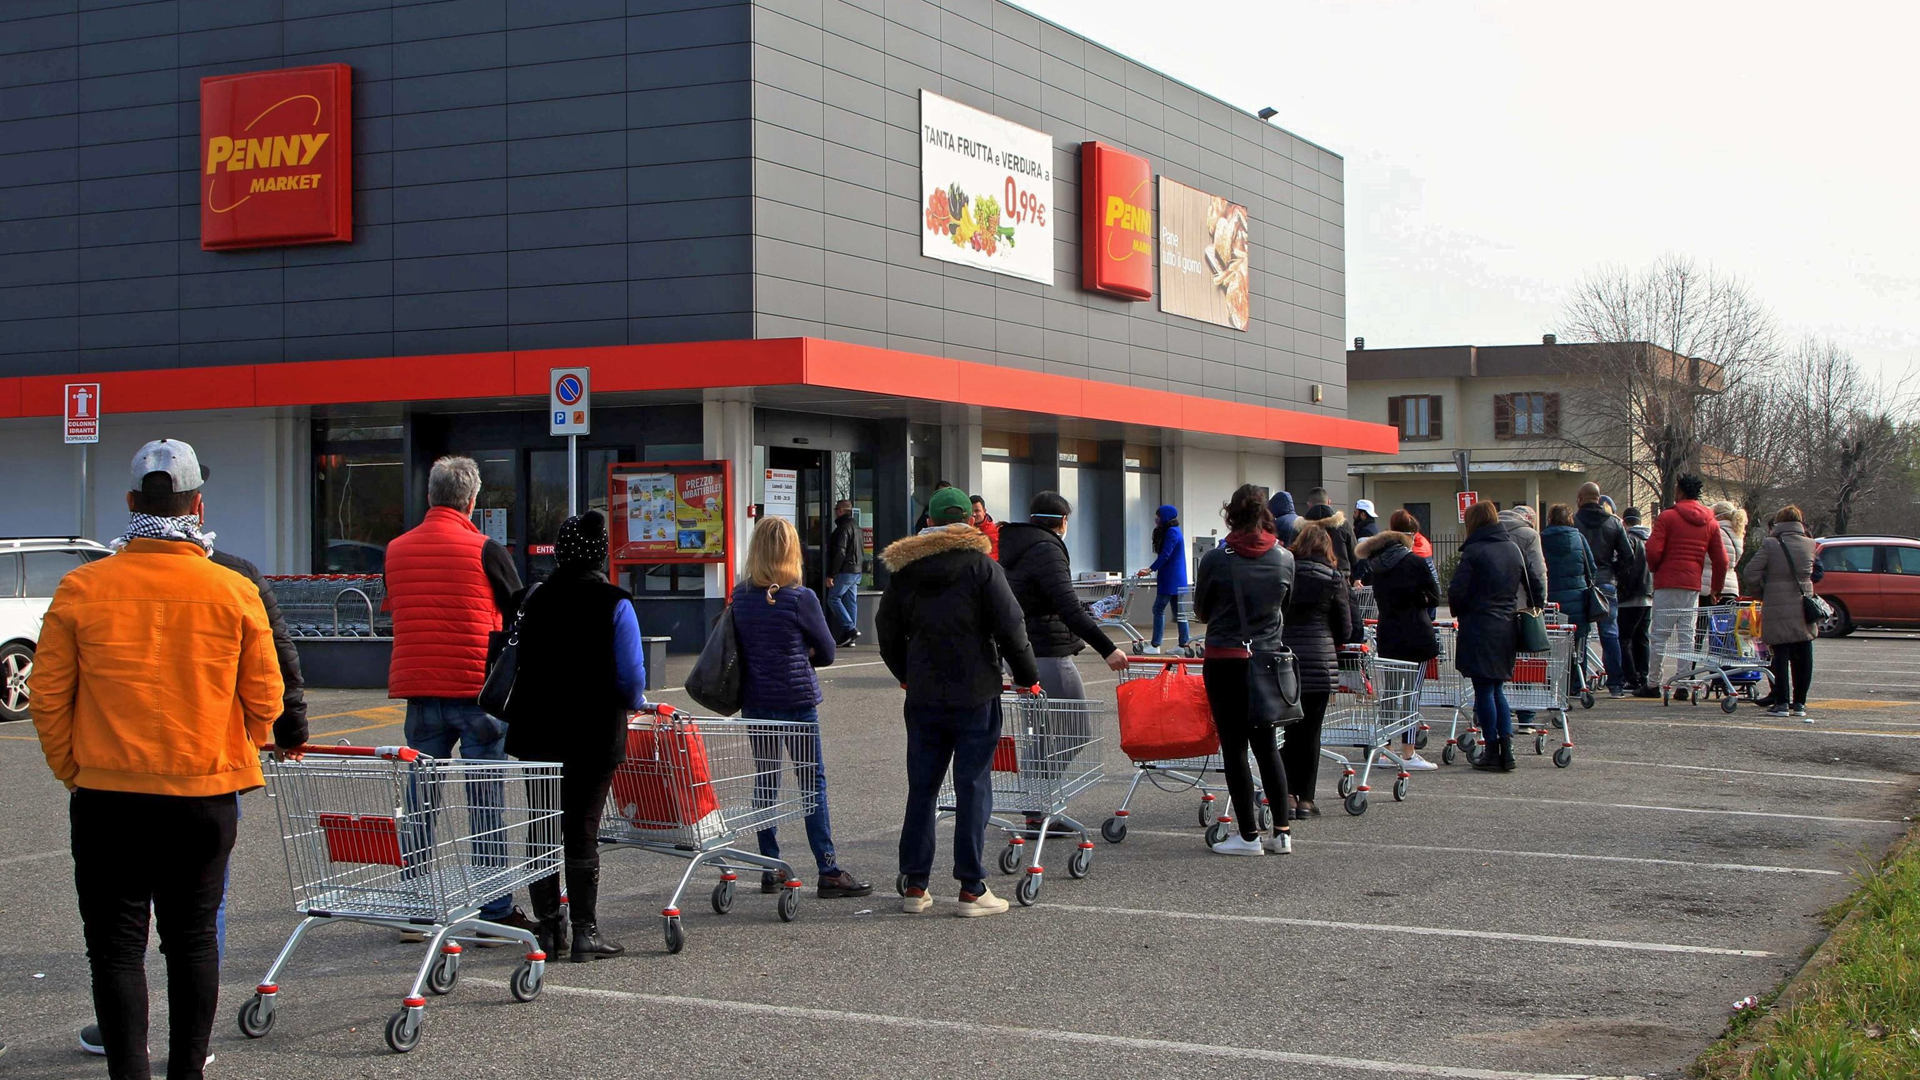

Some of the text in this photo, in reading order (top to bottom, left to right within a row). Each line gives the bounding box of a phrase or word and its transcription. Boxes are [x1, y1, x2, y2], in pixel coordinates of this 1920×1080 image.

[206, 133, 330, 175] PENNY
[924, 125, 1050, 181] TANTA FRUTTA e VERDURA a
[249, 173, 322, 194] MARKET
[1005, 175, 1046, 228] 0,99€
[1105, 195, 1151, 237] PENN
[1162, 226, 1179, 248] Pane
[682, 484, 722, 500] IMBATTIBILE!
[685, 475, 714, 491] PREZZO
[536, 545, 555, 554] ENTR
